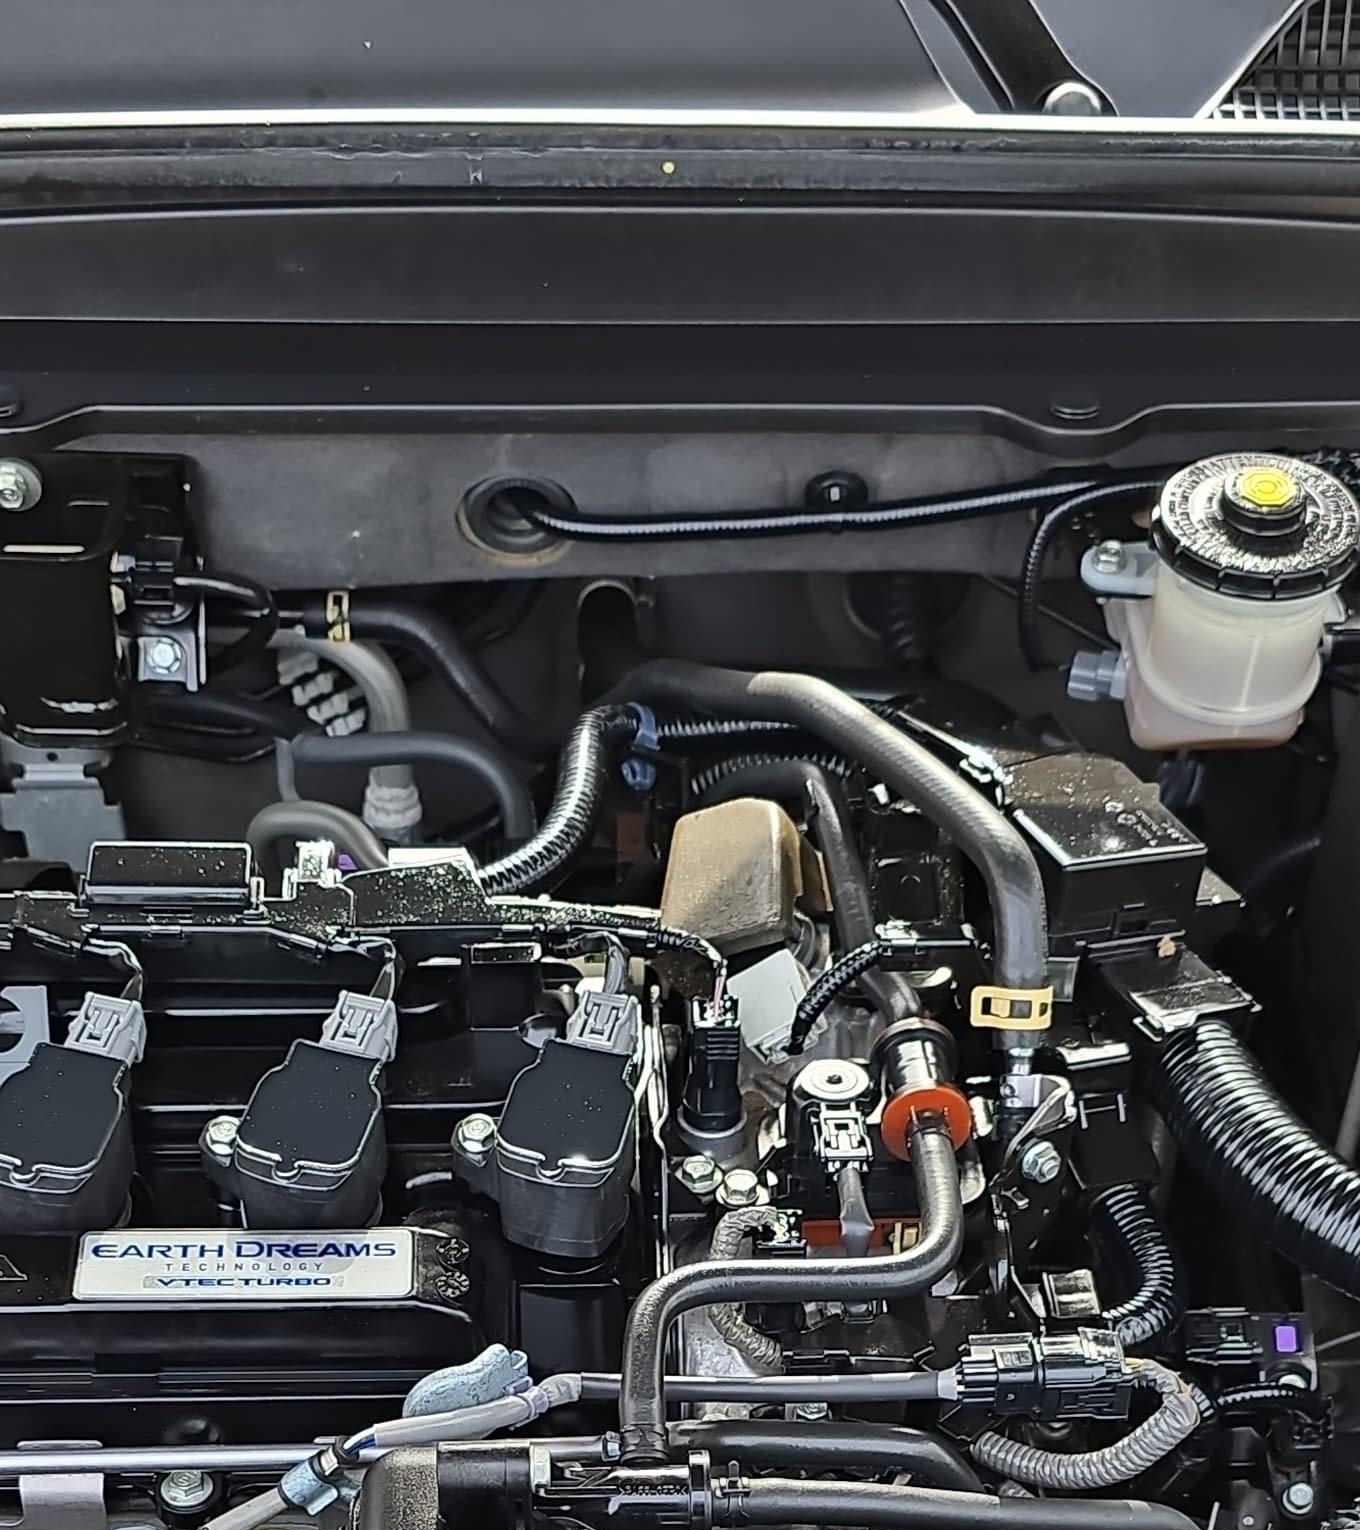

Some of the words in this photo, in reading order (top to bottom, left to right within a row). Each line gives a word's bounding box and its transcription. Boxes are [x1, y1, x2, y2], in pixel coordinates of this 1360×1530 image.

[91, 1243, 226, 1259] EARTH
[235, 1240, 397, 1258] DREAMS
[165, 1263, 324, 1272] TECHNOLOGY
[156, 1278, 234, 1287] VTEC
[241, 1278, 332, 1287] TURBO
